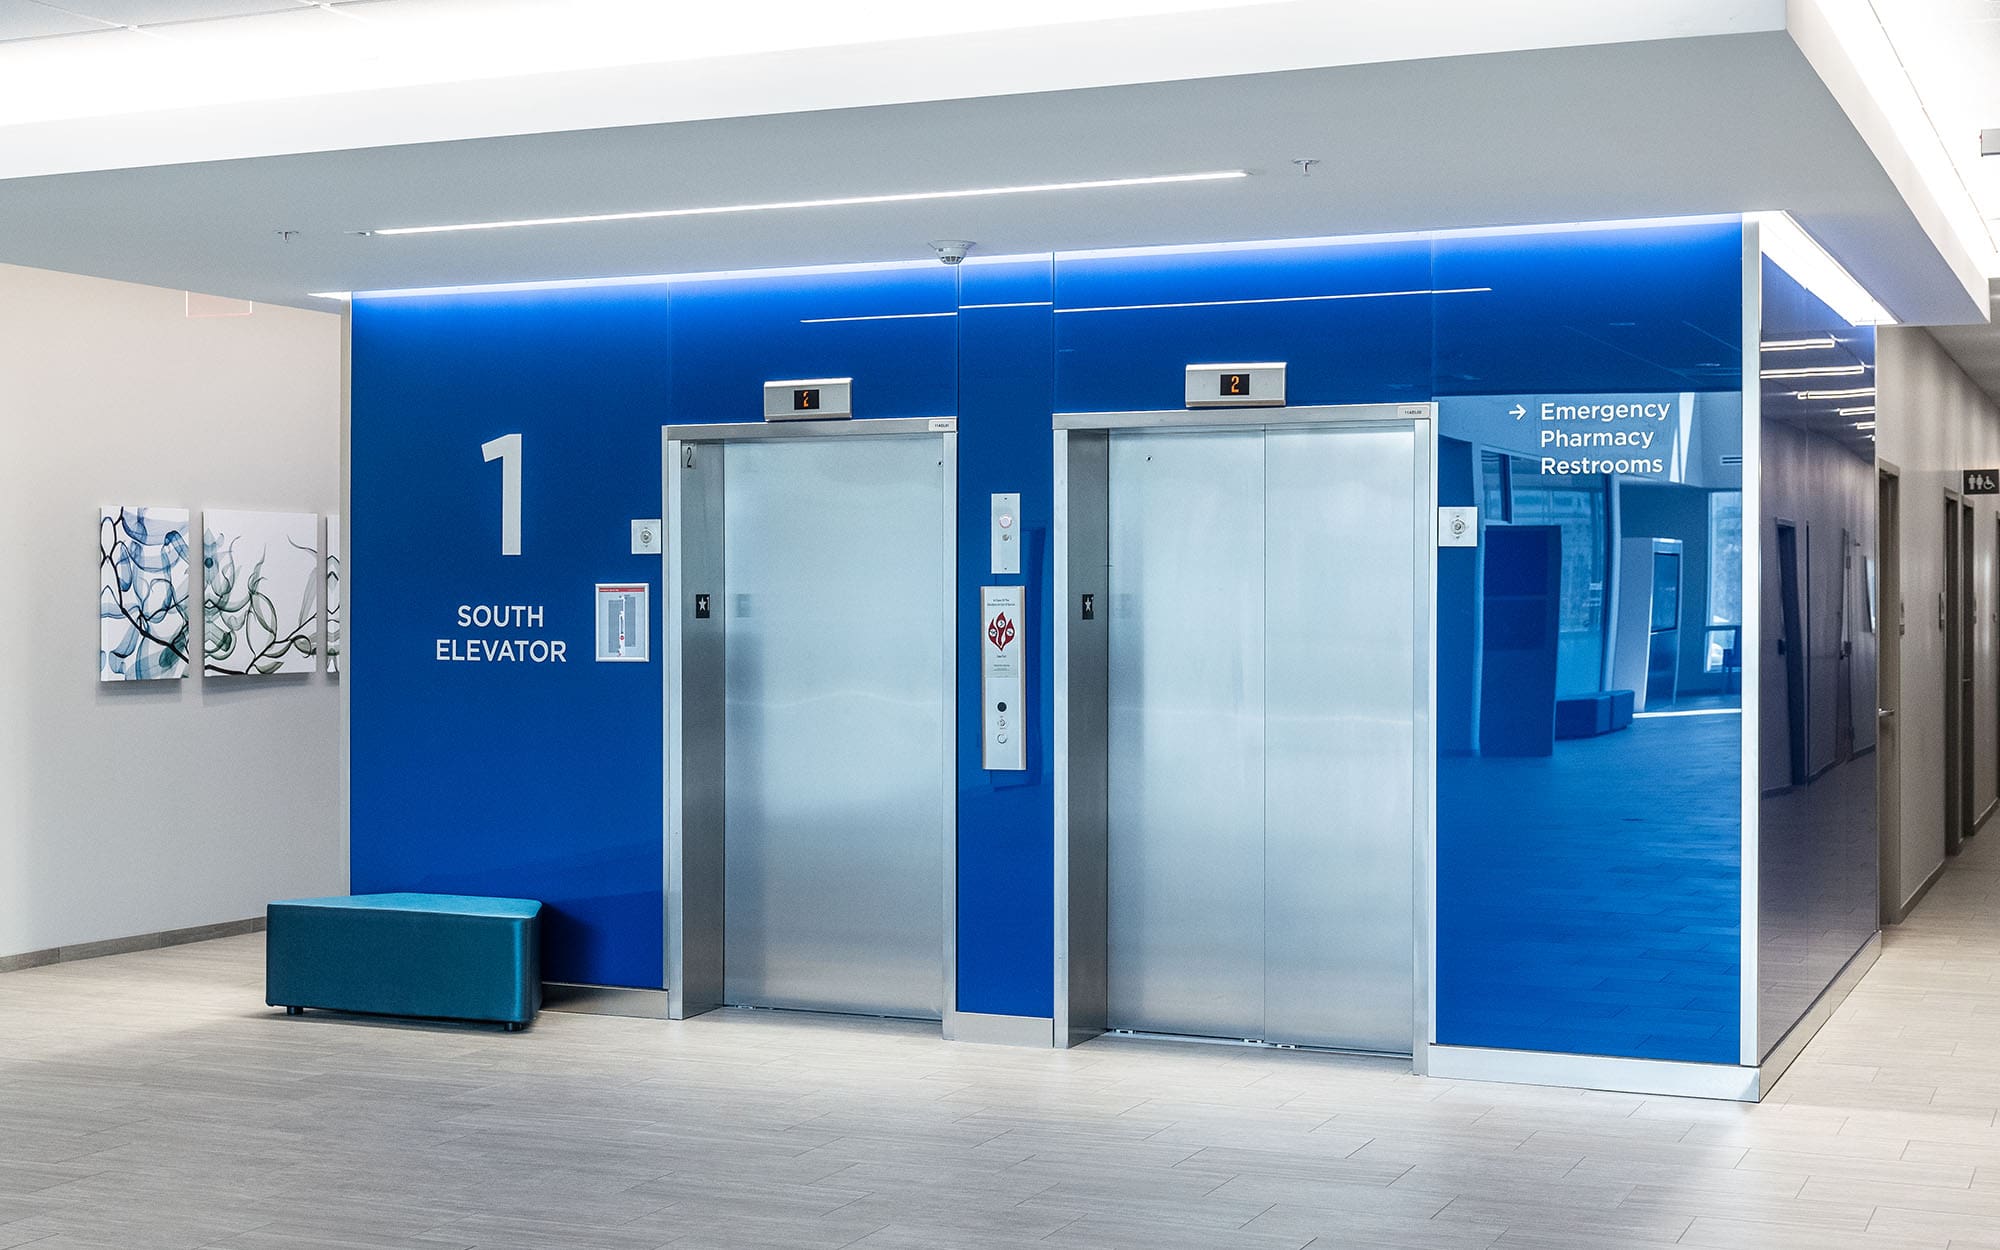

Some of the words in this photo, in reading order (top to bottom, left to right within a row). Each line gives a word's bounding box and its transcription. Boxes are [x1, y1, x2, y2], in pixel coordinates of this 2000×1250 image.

[1231, 375, 1240, 393] 2
[1540, 402, 1671, 424] Emergency
[1540, 430, 1655, 450] Pharmacy
[686, 446, 693, 468] 2
[1540, 456, 1664, 475] Restrooms
[481, 433, 522, 556] 1
[457, 604, 545, 628] SOUTH
[436, 638, 567, 663] ELEVATOR
